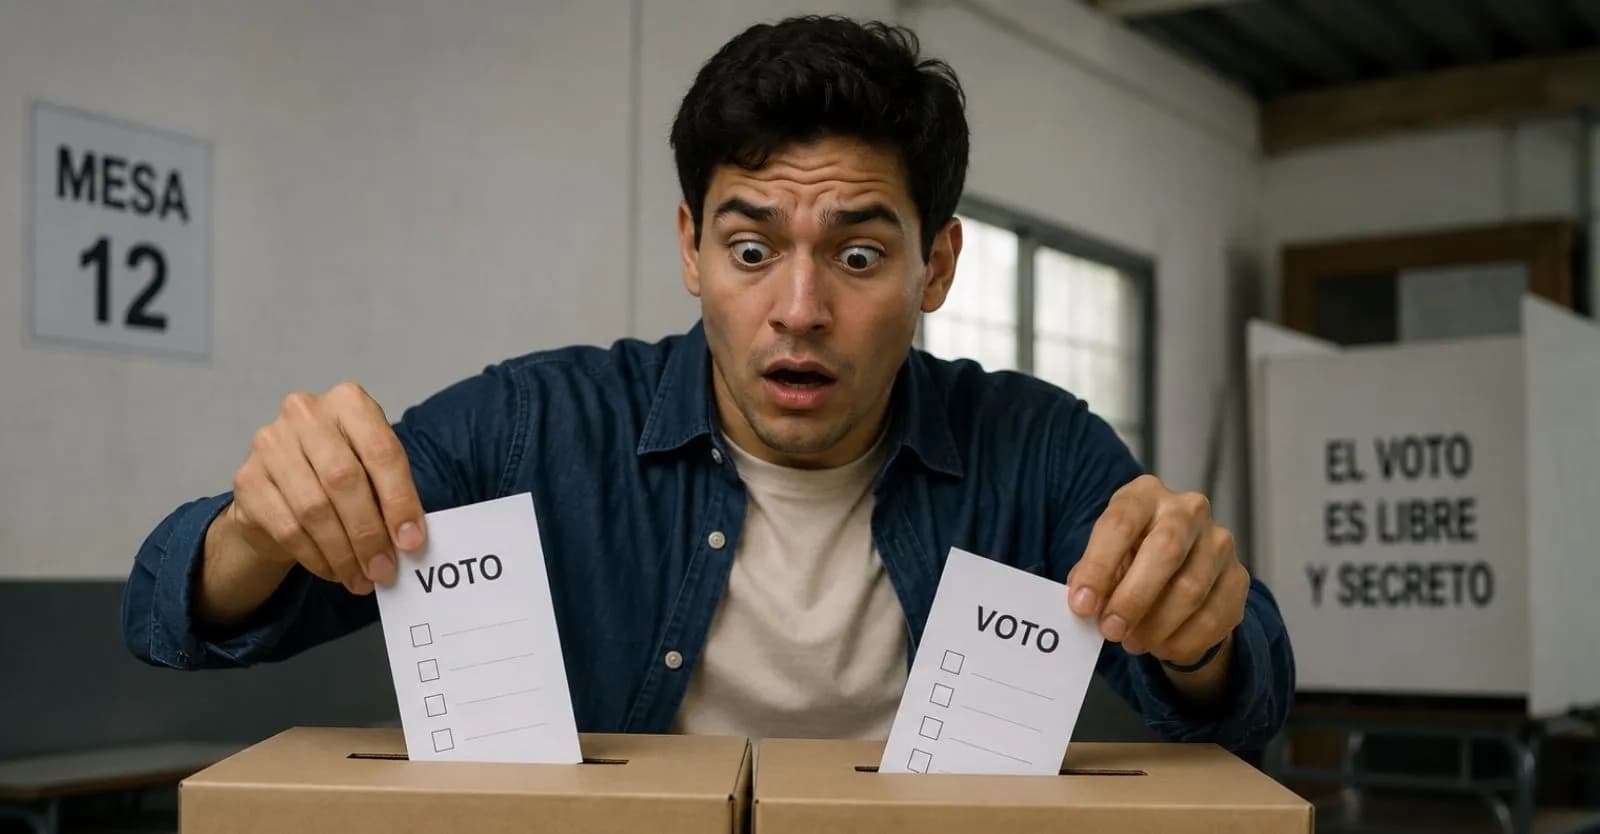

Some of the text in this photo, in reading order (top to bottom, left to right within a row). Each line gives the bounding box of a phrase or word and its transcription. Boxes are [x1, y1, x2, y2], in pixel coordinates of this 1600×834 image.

[56, 144, 190, 223] MESA
[79, 235, 169, 332] 12
[1325, 433, 1472, 483] EL VOTO
[1325, 498, 1478, 546] ES LIBRE
[415, 554, 504, 593] VOTO
[1306, 562, 1496, 608] Y SECRETO
[977, 605, 1060, 654] VOTO
